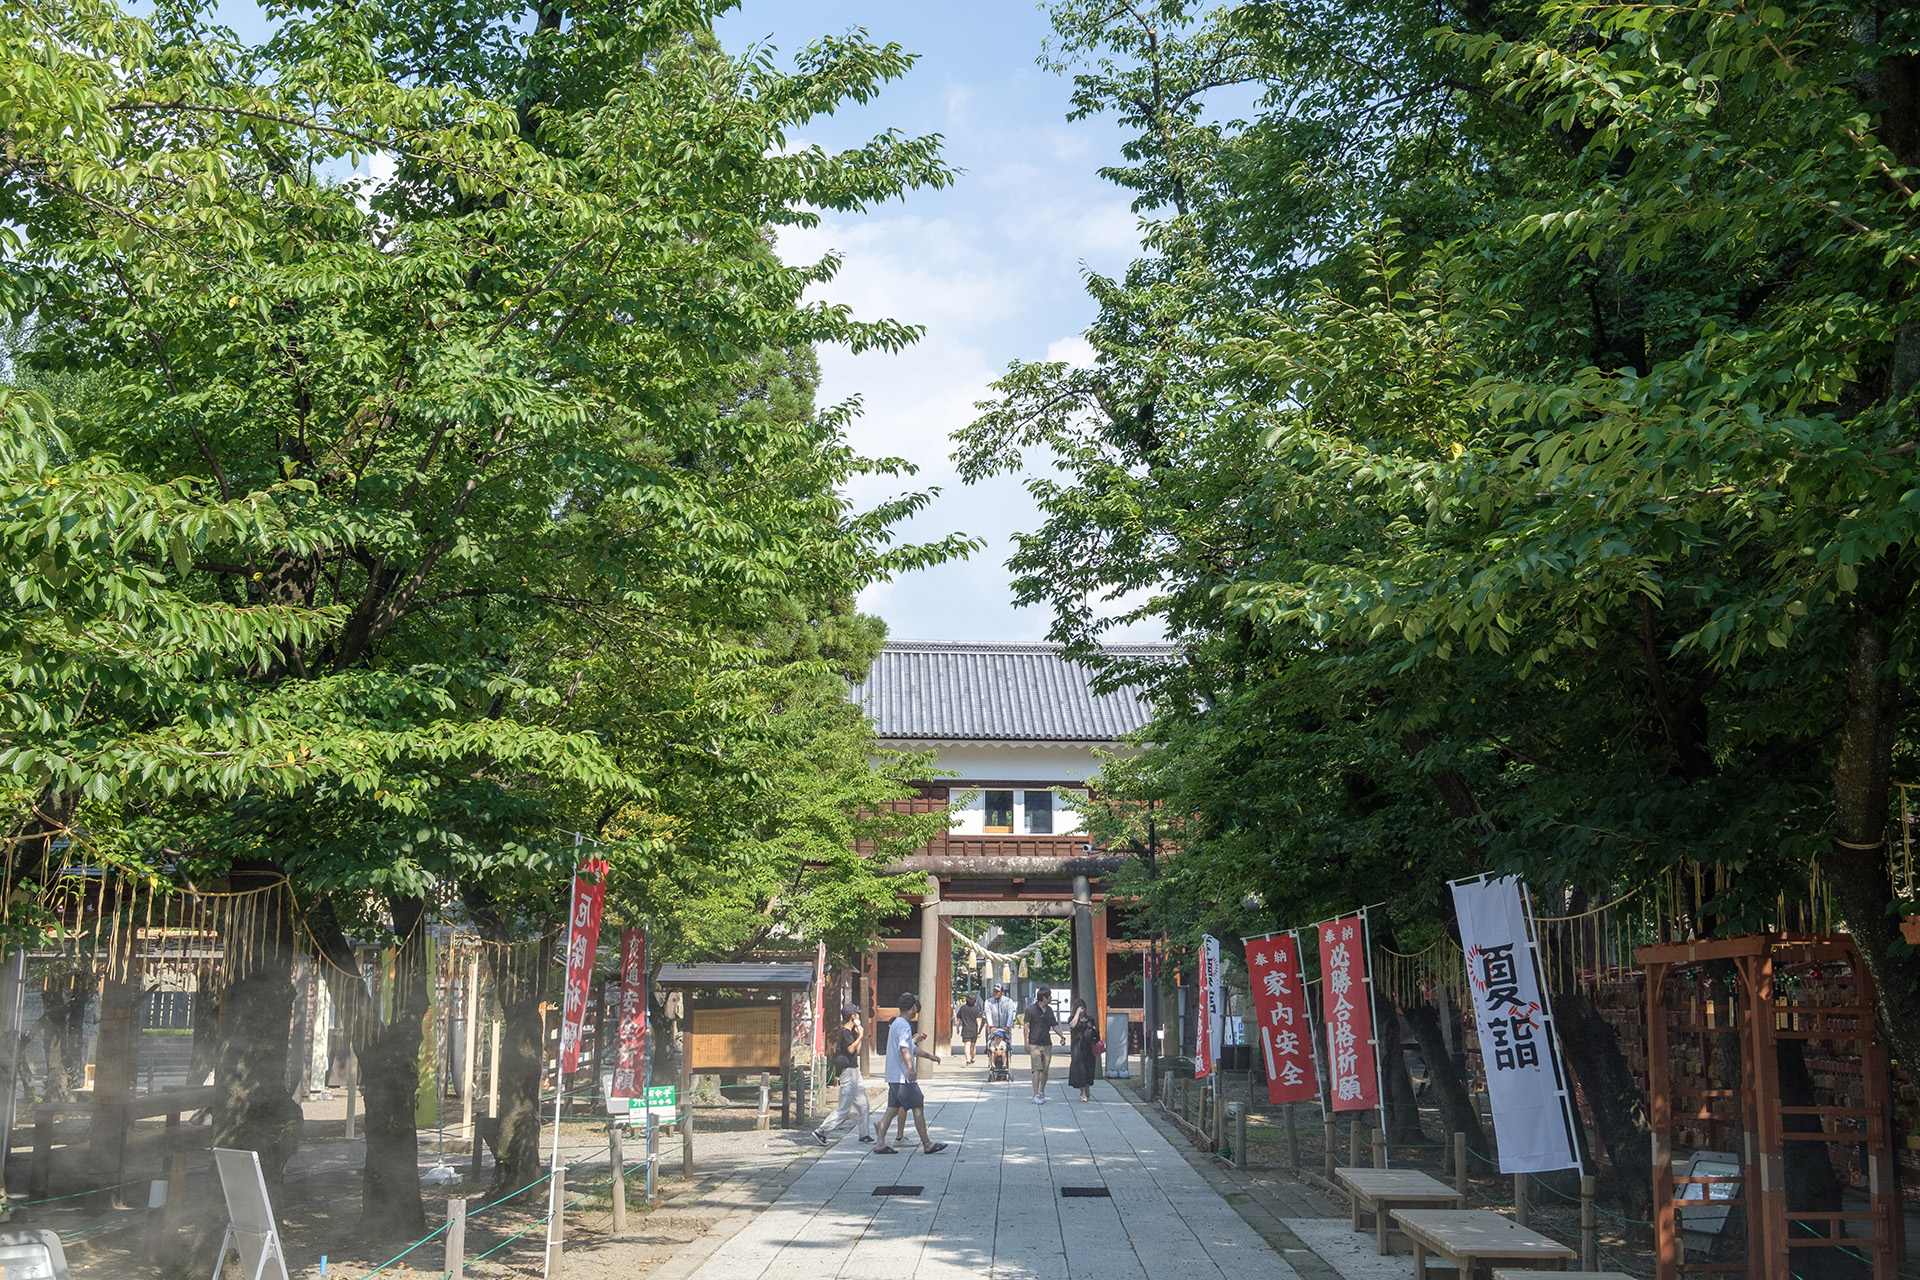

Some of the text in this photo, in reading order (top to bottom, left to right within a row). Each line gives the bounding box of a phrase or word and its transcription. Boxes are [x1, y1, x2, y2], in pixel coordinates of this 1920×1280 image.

[1255, 949, 1288, 966] 奉納
[1324, 925, 1354, 944] 奉納
[614, 935, 641, 1092] 交通安全祈願
[1263, 970, 1304, 1087] 家内安全
[1329, 942, 1364, 1101] 必勝合格祈願
[1478, 943, 1539, 1071] 夏詣
